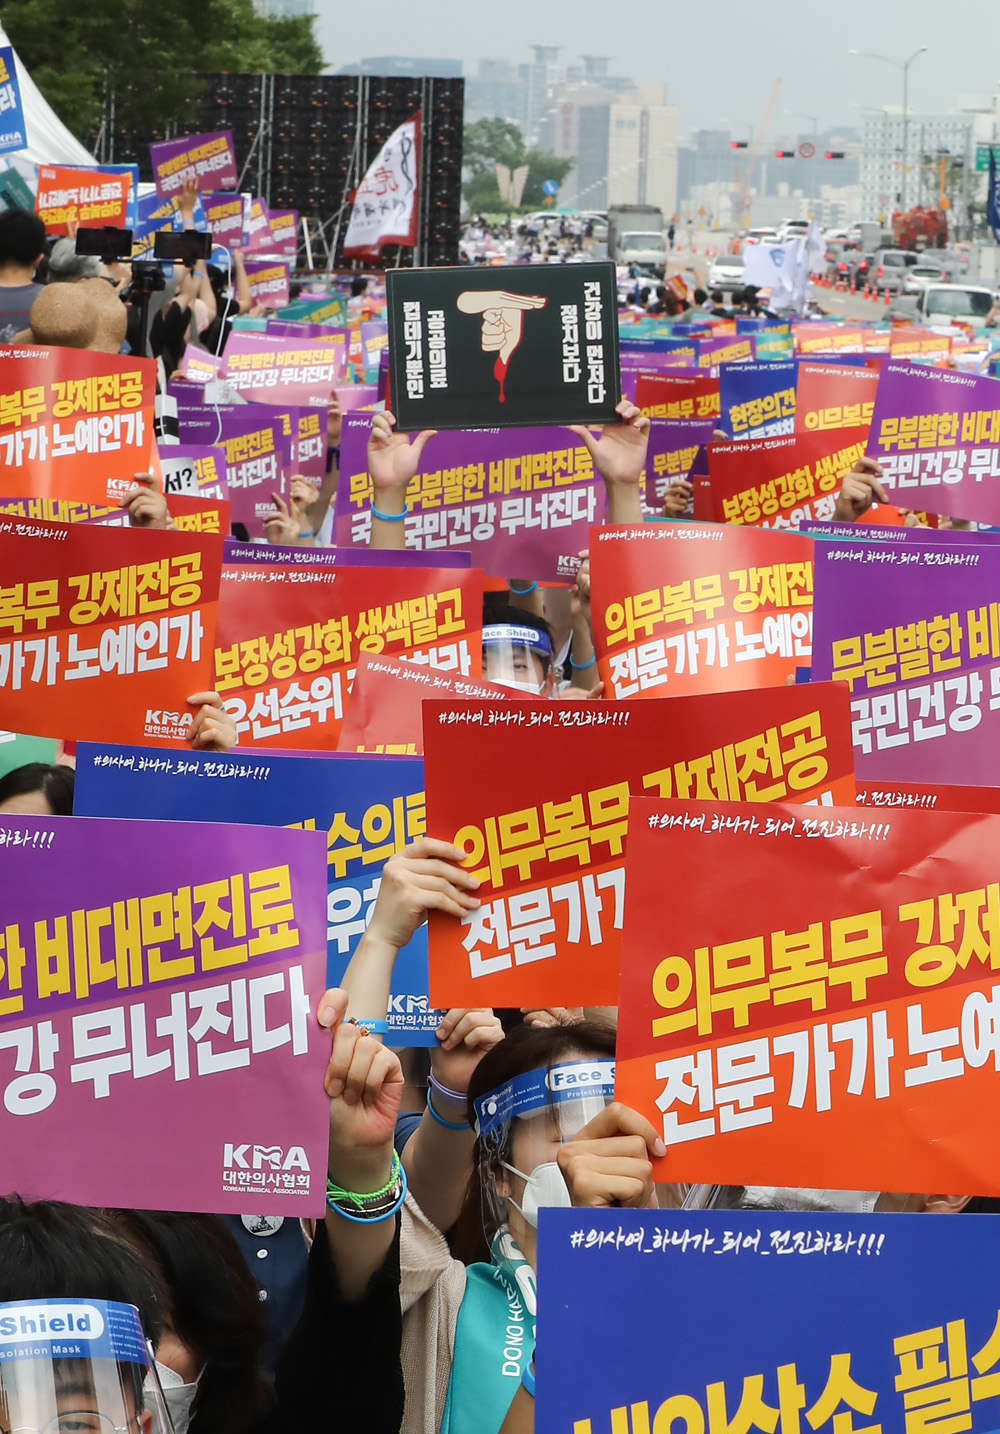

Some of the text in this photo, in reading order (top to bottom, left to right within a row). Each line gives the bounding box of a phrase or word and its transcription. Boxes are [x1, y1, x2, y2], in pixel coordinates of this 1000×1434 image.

[427, 310, 448, 388] 공공의료
[560, 305, 581, 382] 정치보다
[584, 282, 606, 404] 건강이 먼저다
[51, 371, 143, 418] 강제전공
[888, 365, 977, 388] #의사여_하나가_되어_전진하라!!!
[729, 388, 796, 433] 현장의견
[878, 412, 959, 452] 무분별한
[52, 411, 145, 459] 노예인가
[489, 445, 594, 494] 비대면진료
[875, 449, 967, 489] 국민건강
[404, 486, 596, 550] 국민건강 무너진다
[722, 465, 815, 525] 보장성강화
[231, 549, 336, 565] #의사여_하나가_되어_전진하라!!!
[598, 529, 724, 541] #의사여_하나가_되어_전진하라!!!
[827, 550, 980, 567] #의사여_하나가_되어_전진하라!!!
[68, 552, 203, 625] 강제전공
[604, 561, 813, 647] 의무복무 강제전
[64, 610, 203, 681] 노예인가
[214, 616, 352, 693] 보장성강화
[355, 587, 465, 655] 생색말고
[506, 629, 536, 639] Shield
[609, 611, 813, 700] 전문가가 노예인
[831, 612, 963, 692] 무분별한
[145, 709, 193, 726] KMA
[438, 710, 630, 728] #의사여_하나가_되어_전진하라!!!
[850, 672, 984, 755] 국민건강
[93, 754, 271, 782] #의사여_하나가_되어_전진하라!!!
[452, 710, 829, 890] 의무복무 강제전공
[647, 813, 892, 842] #의사여_하나가_되어_전진하라!!!
[35, 864, 300, 1000] 비대면진료
[651, 908, 888, 1038] 의무복무
[70, 965, 310, 1100] 무너진다
[554, 1068, 601, 1086] Face
[653, 1009, 894, 1146] 전문가가
[223, 1143, 311, 1172] KMA
[223, 1171, 311, 1189] 대한의사협회
[569, 1227, 886, 1258] #의사여_하나가_되어_전진하라!!!
[0, 1313, 91, 1336] Shield
[0, 1345, 81, 1358] solation Mask
